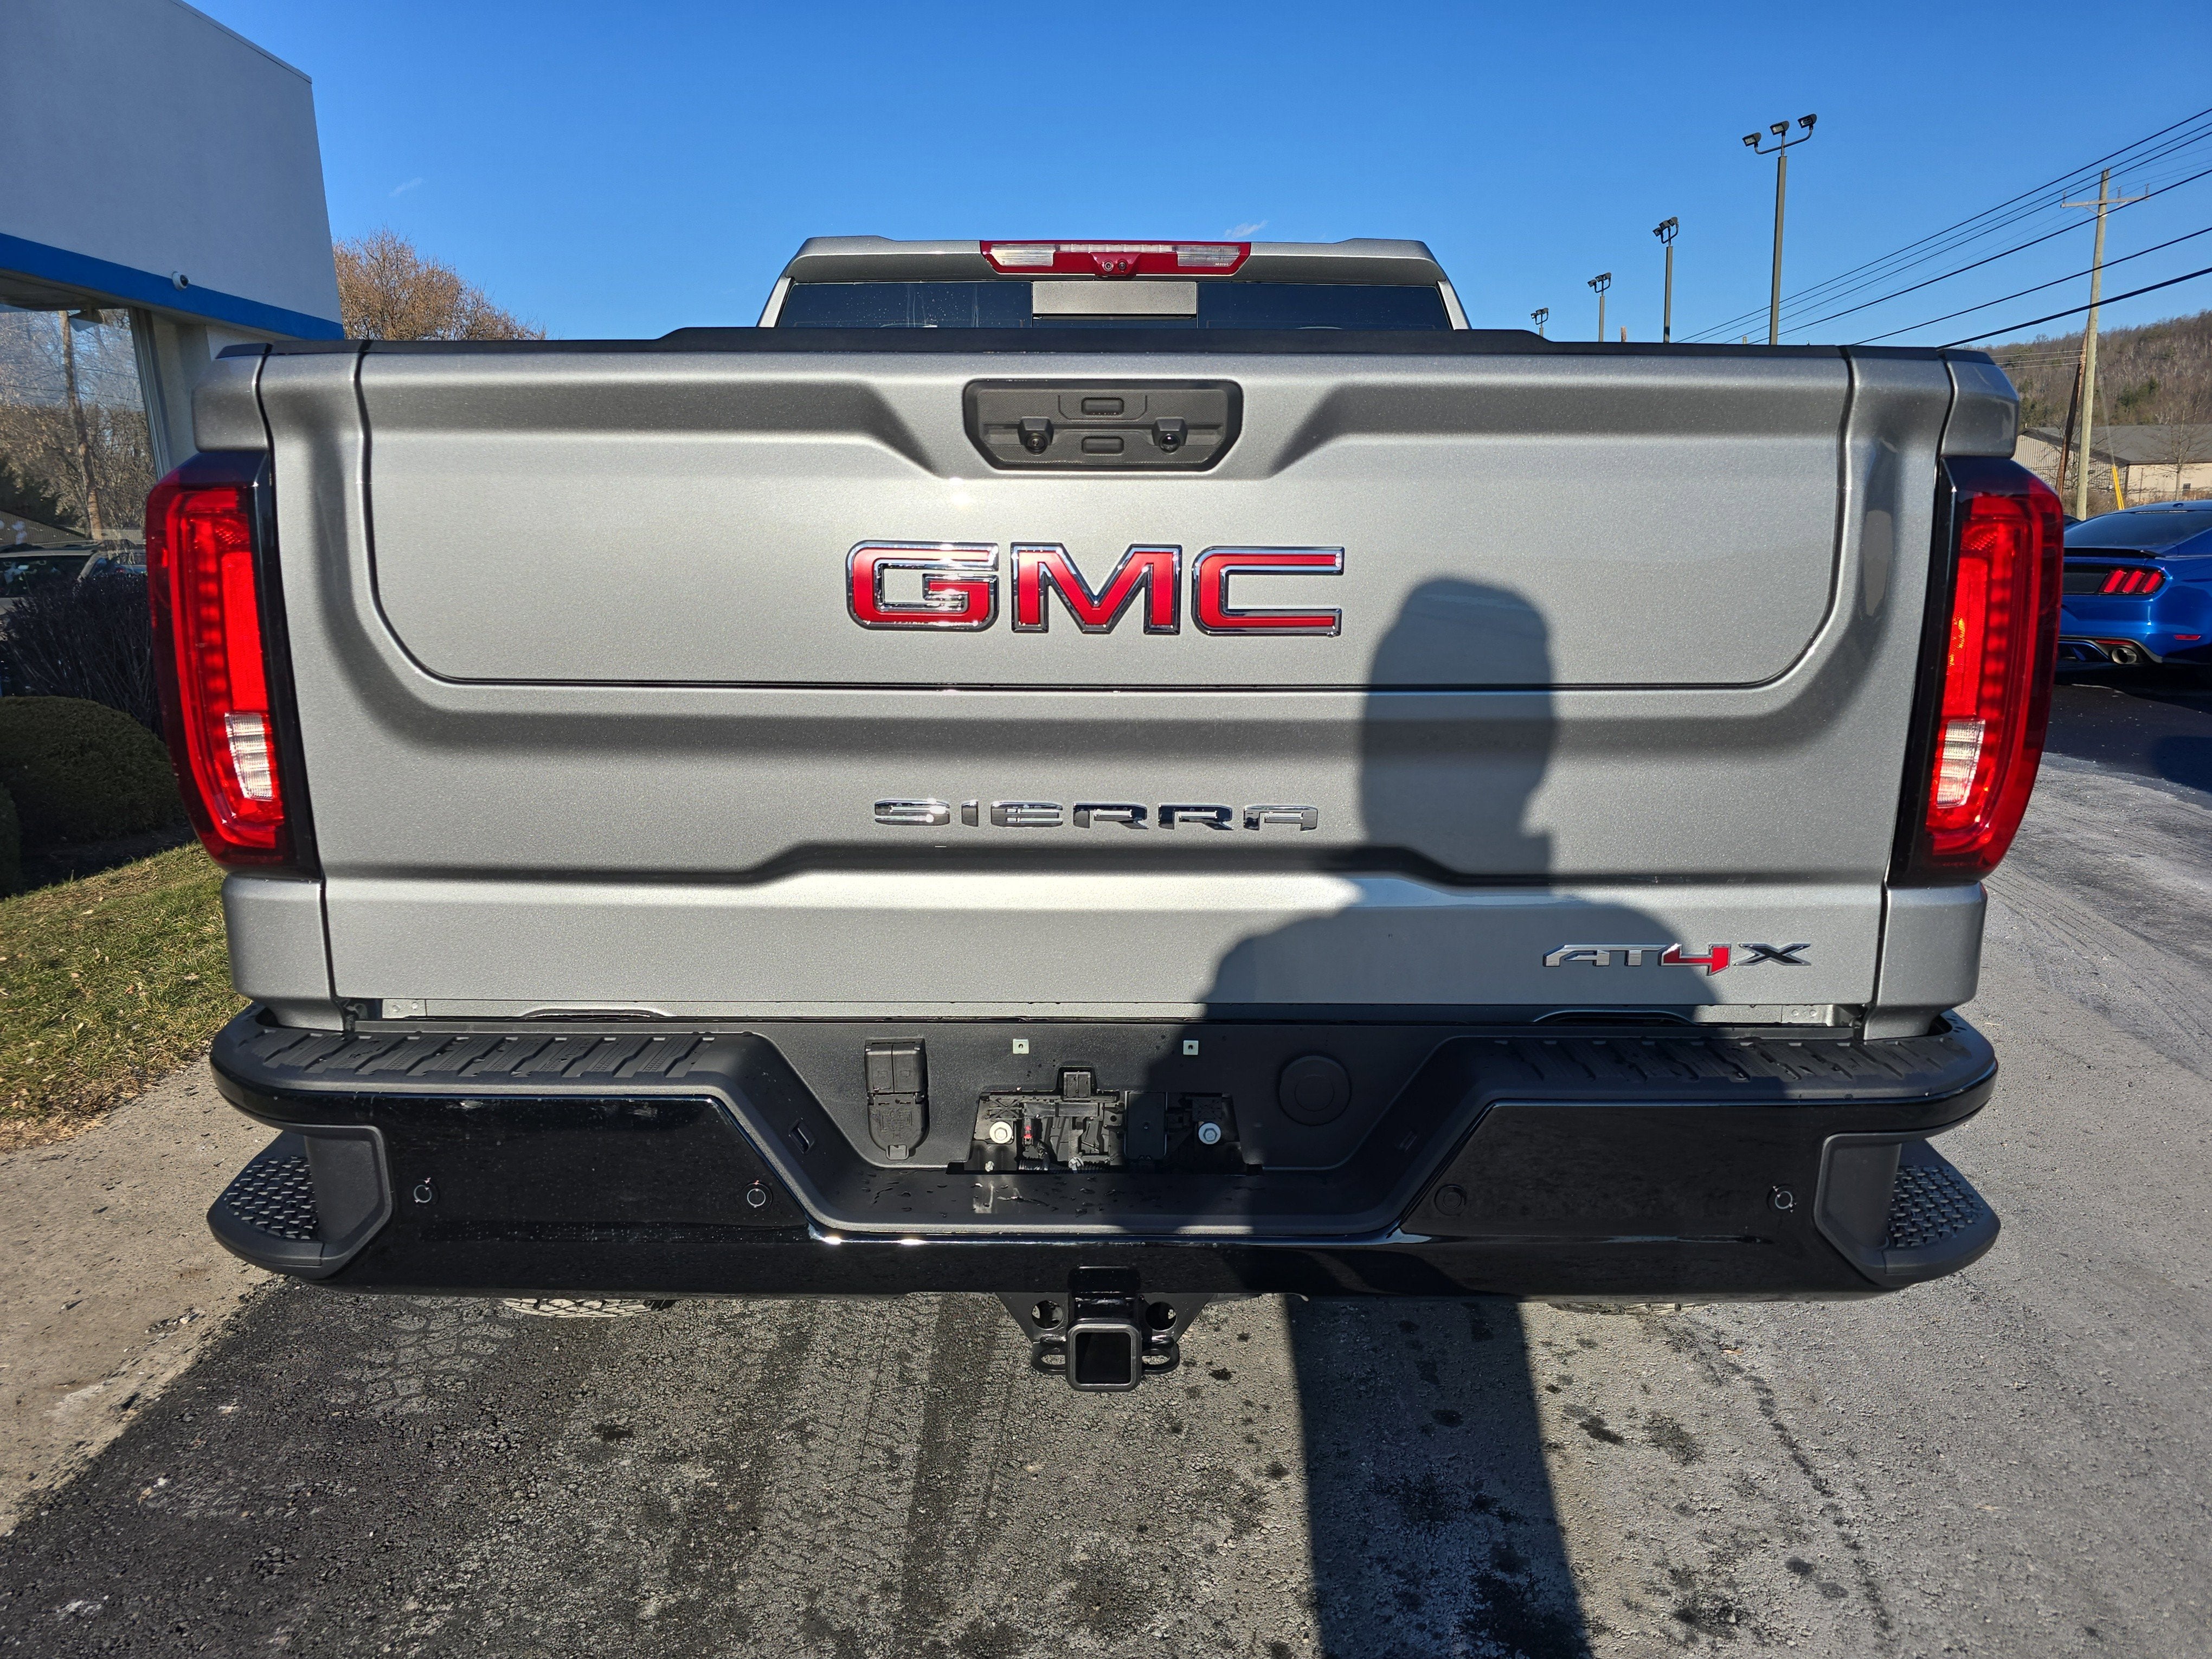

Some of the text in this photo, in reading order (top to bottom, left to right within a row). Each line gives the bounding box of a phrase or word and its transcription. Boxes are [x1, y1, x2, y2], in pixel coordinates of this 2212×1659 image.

[846, 541, 1345, 636] GMC
[874, 799, 1319, 831] SIERRA
[1544, 943, 1811, 975] AT4X
